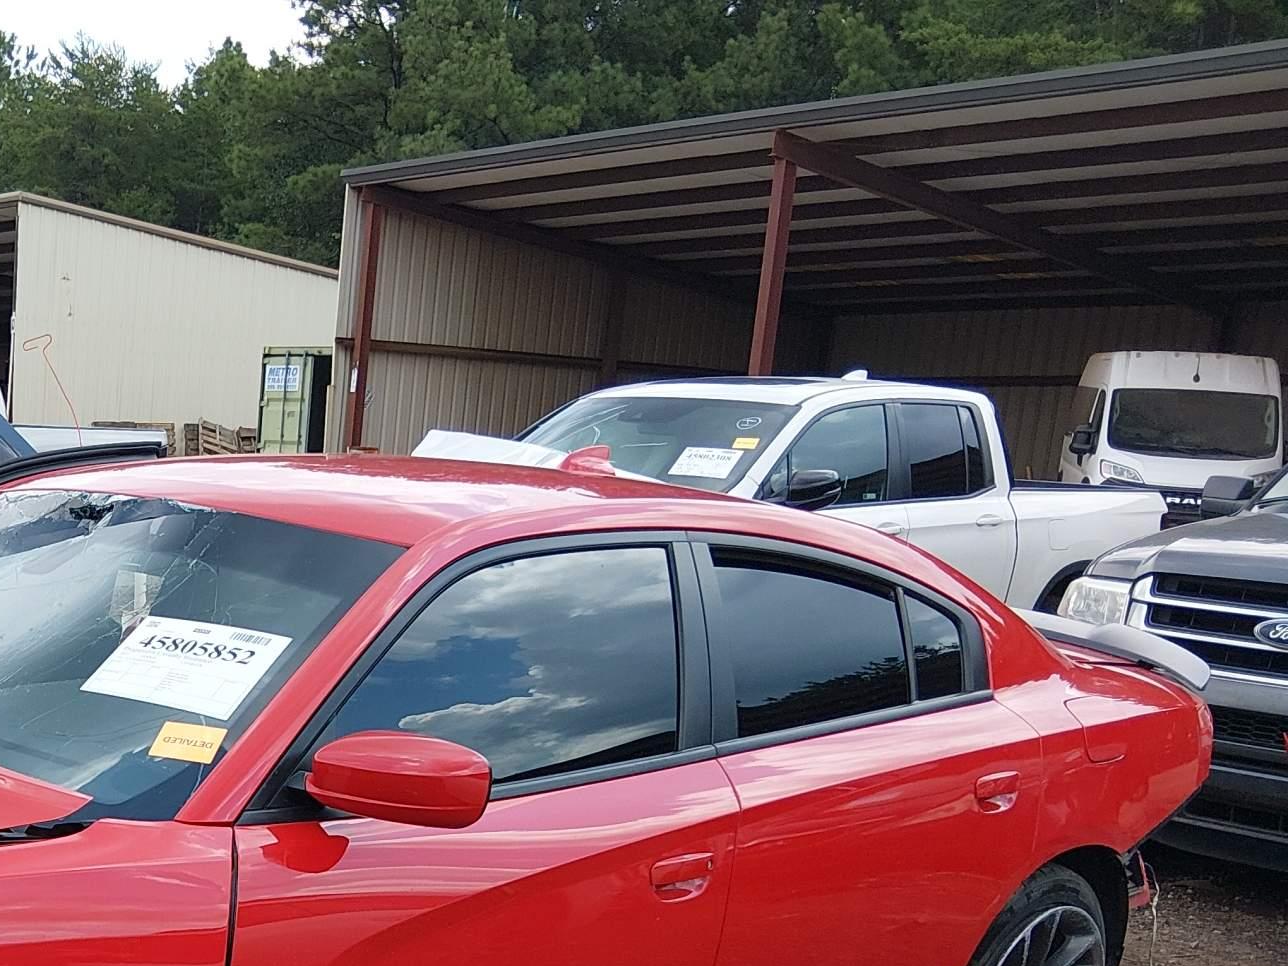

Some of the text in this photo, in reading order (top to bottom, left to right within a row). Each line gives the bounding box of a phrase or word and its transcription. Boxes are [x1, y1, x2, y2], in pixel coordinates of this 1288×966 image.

[268, 367, 298, 377] METRO
[139, 635, 256, 665] 45805852
[162, 736, 214, 749] DETAILED
